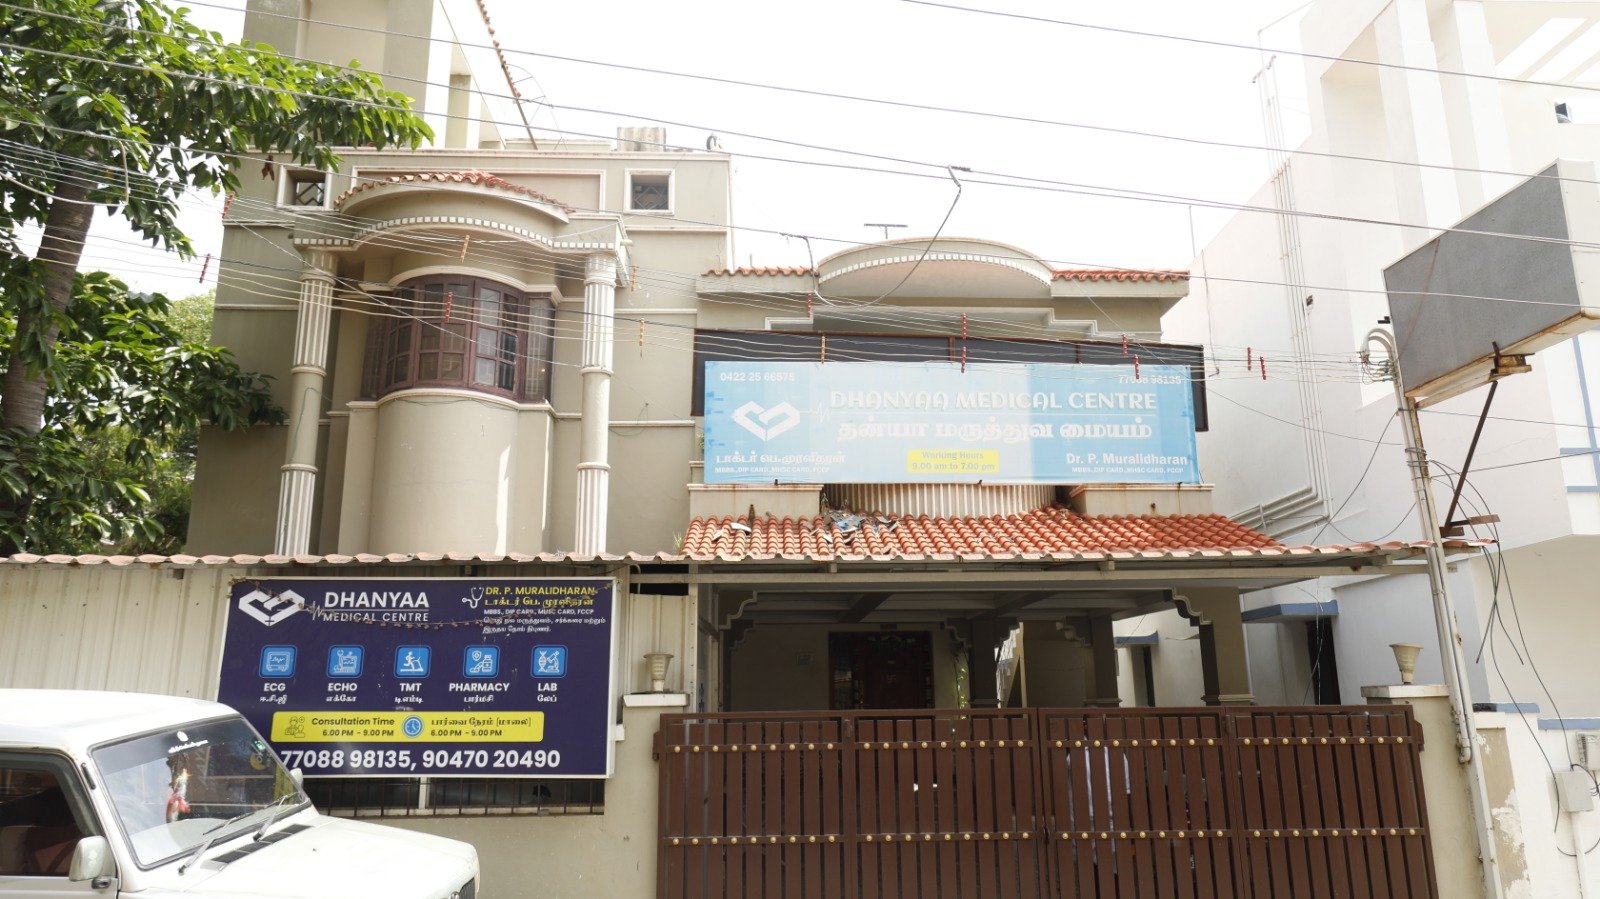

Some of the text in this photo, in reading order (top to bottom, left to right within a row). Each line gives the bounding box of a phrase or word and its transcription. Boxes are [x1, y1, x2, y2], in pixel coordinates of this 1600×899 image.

[720, 372, 795, 382] 0422 25 66575
[830, 390, 1156, 411] DHANYAA MEDICAL CENTRE
[837, 416, 1152, 442] தன்யா மருத்துவ மையம்
[716, 450, 758, 464] டாக்டர்
[922, 451, 957, 460] Working
[1066, 453, 1188, 465] Dr. P. Muralidharan
[485, 587, 595, 596] DR. P. MURALIDHARAN
[324, 592, 430, 608] DHANYAA
[484, 598, 520, 606] டாக்டர்
[323, 612, 428, 622] MEDICAL CENTRE
[264, 683, 286, 692] ECG
[328, 683, 357, 692] ECHO
[400, 683, 422, 692] TMT
[449, 683, 510, 692] PHARMACY
[537, 683, 558, 692] LAB
[312, 717, 395, 726] Consultation Time
[431, 717, 467, 727] பார்வை
[468, 717, 493, 727] நேரம்
[280, 750, 560, 771] 77088 98135, 90470 20490
